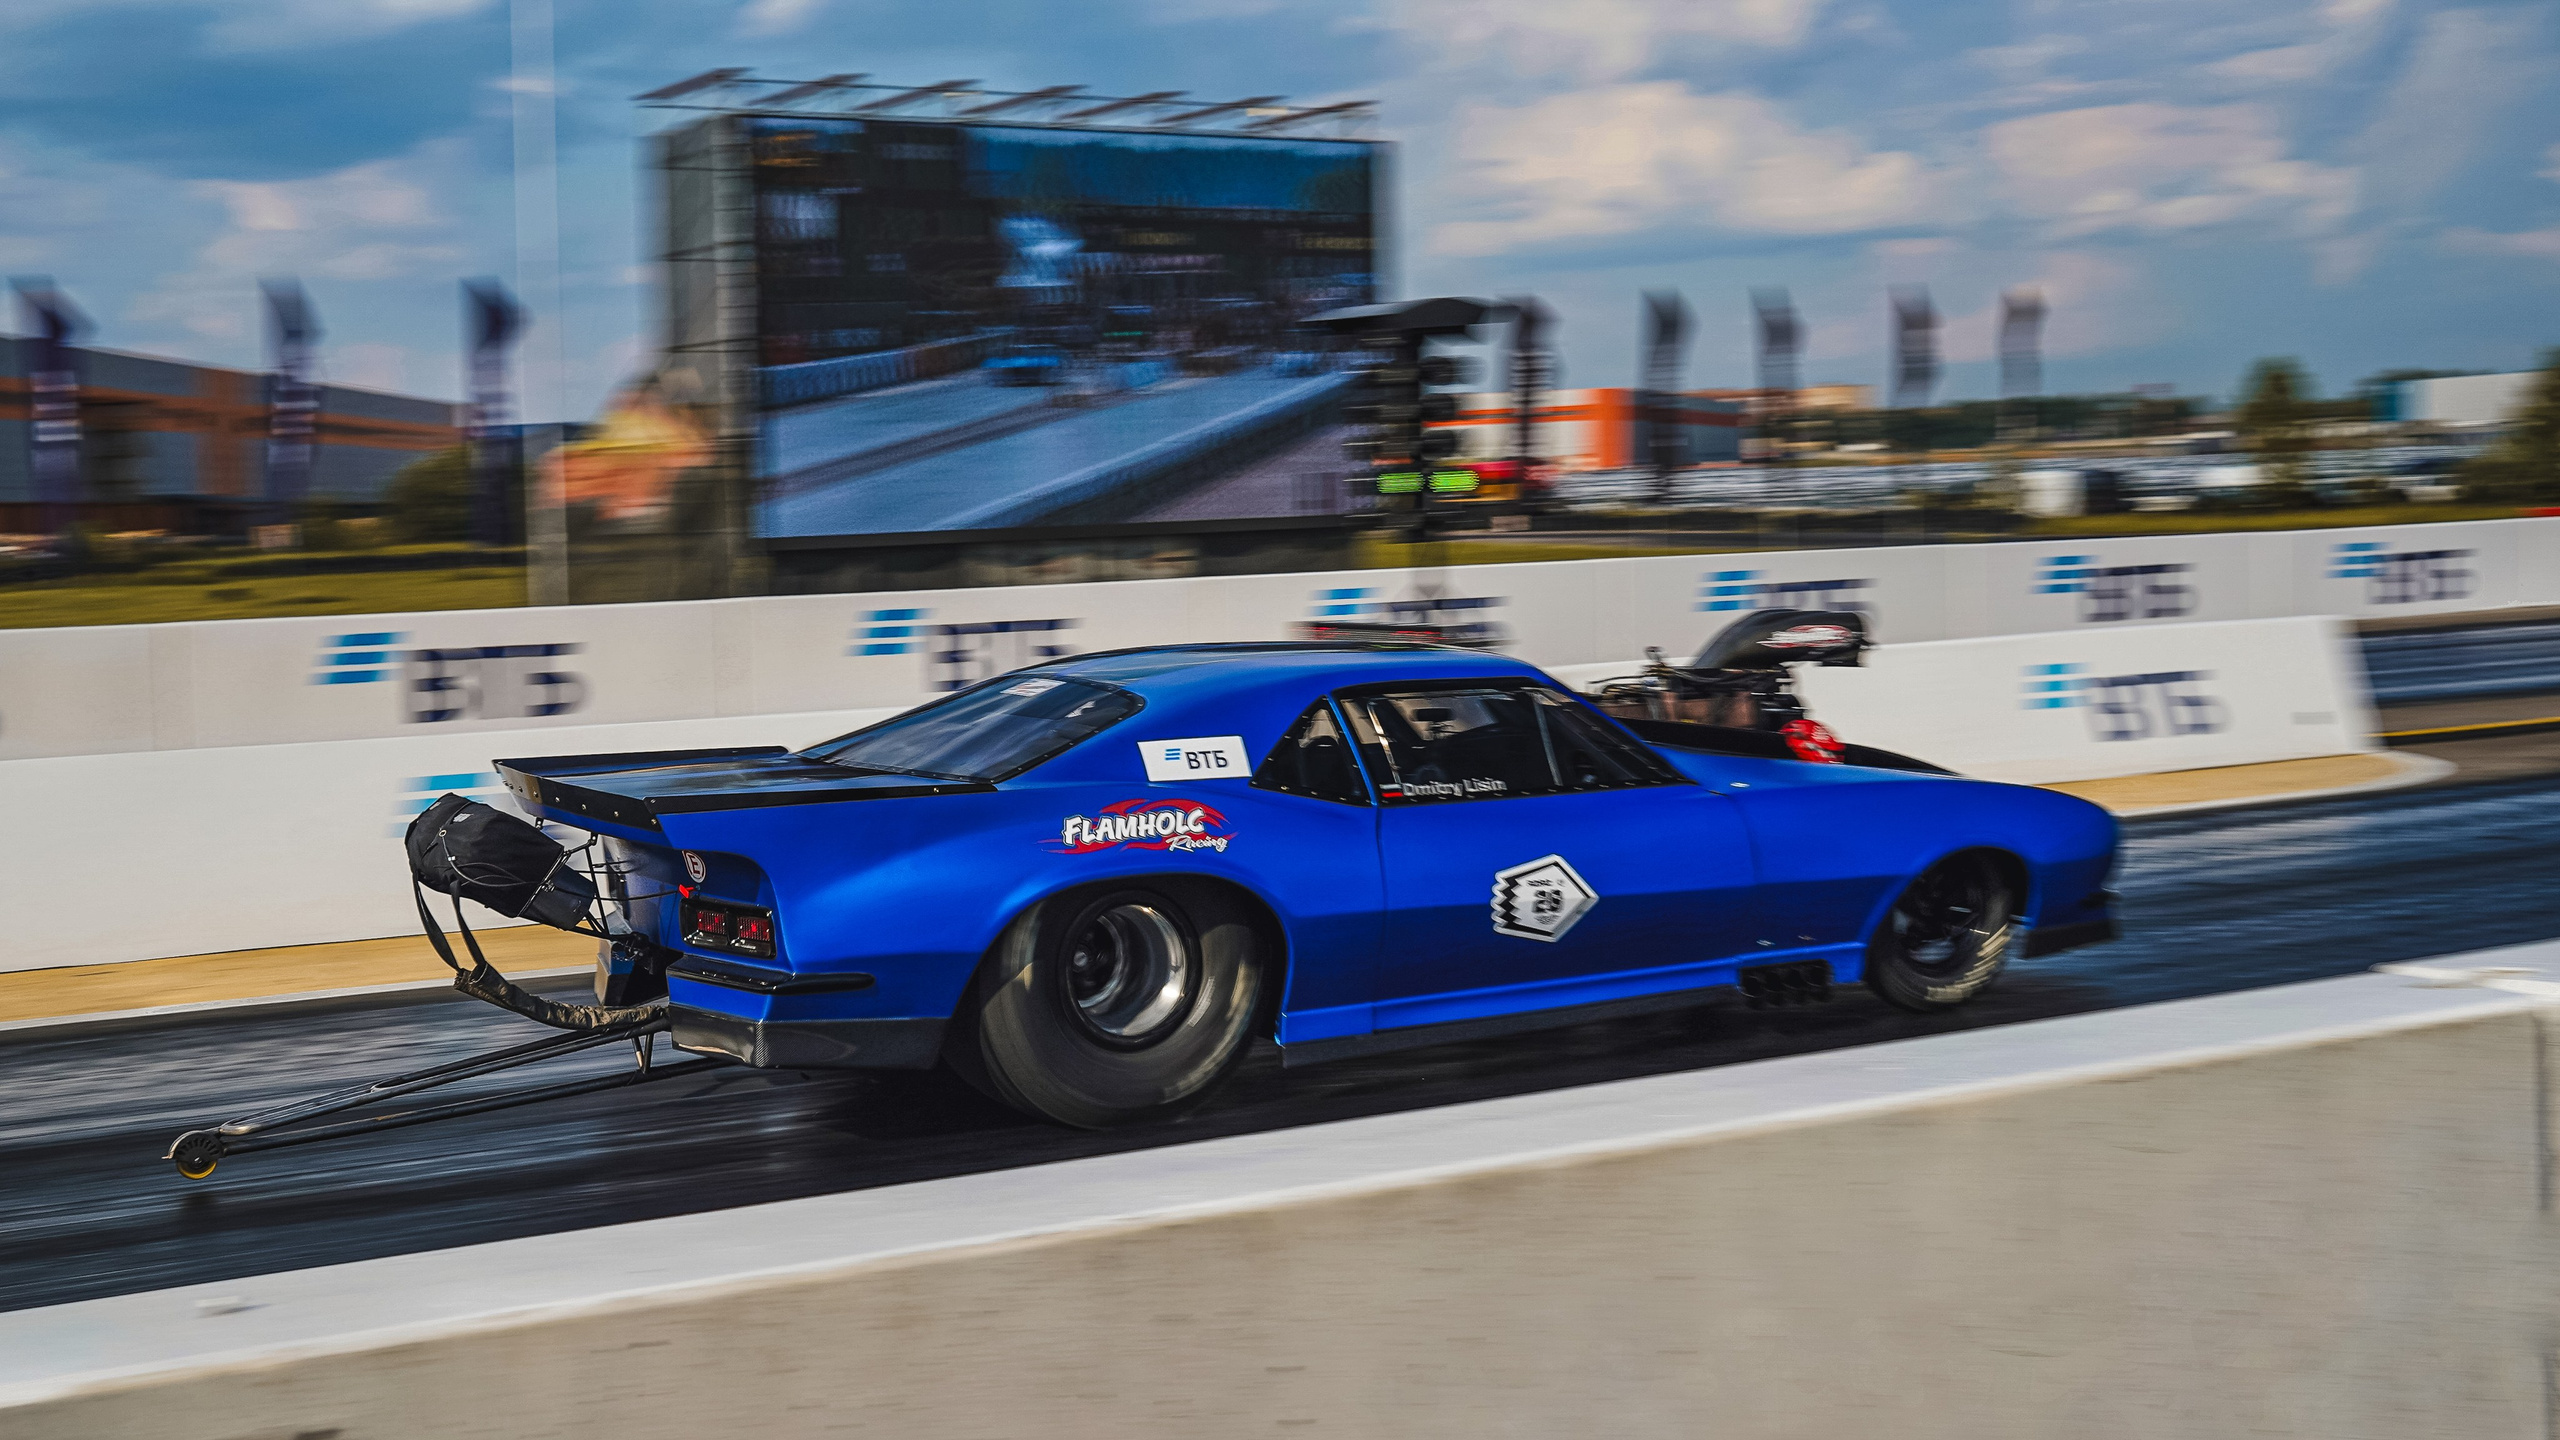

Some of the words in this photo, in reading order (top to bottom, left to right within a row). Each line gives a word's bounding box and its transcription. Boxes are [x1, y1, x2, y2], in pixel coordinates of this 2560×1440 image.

[404, 643, 588, 724] ВТБ
[2085, 669, 2233, 742] ВТБ
[1185, 750, 1228, 769] ВТБ
[1402, 781, 1463, 796] Dmitry
[1463, 777, 1507, 793] Lisin
[1062, 807, 1206, 846] FLAMHOLC
[1165, 835, 1228, 852] Racing
